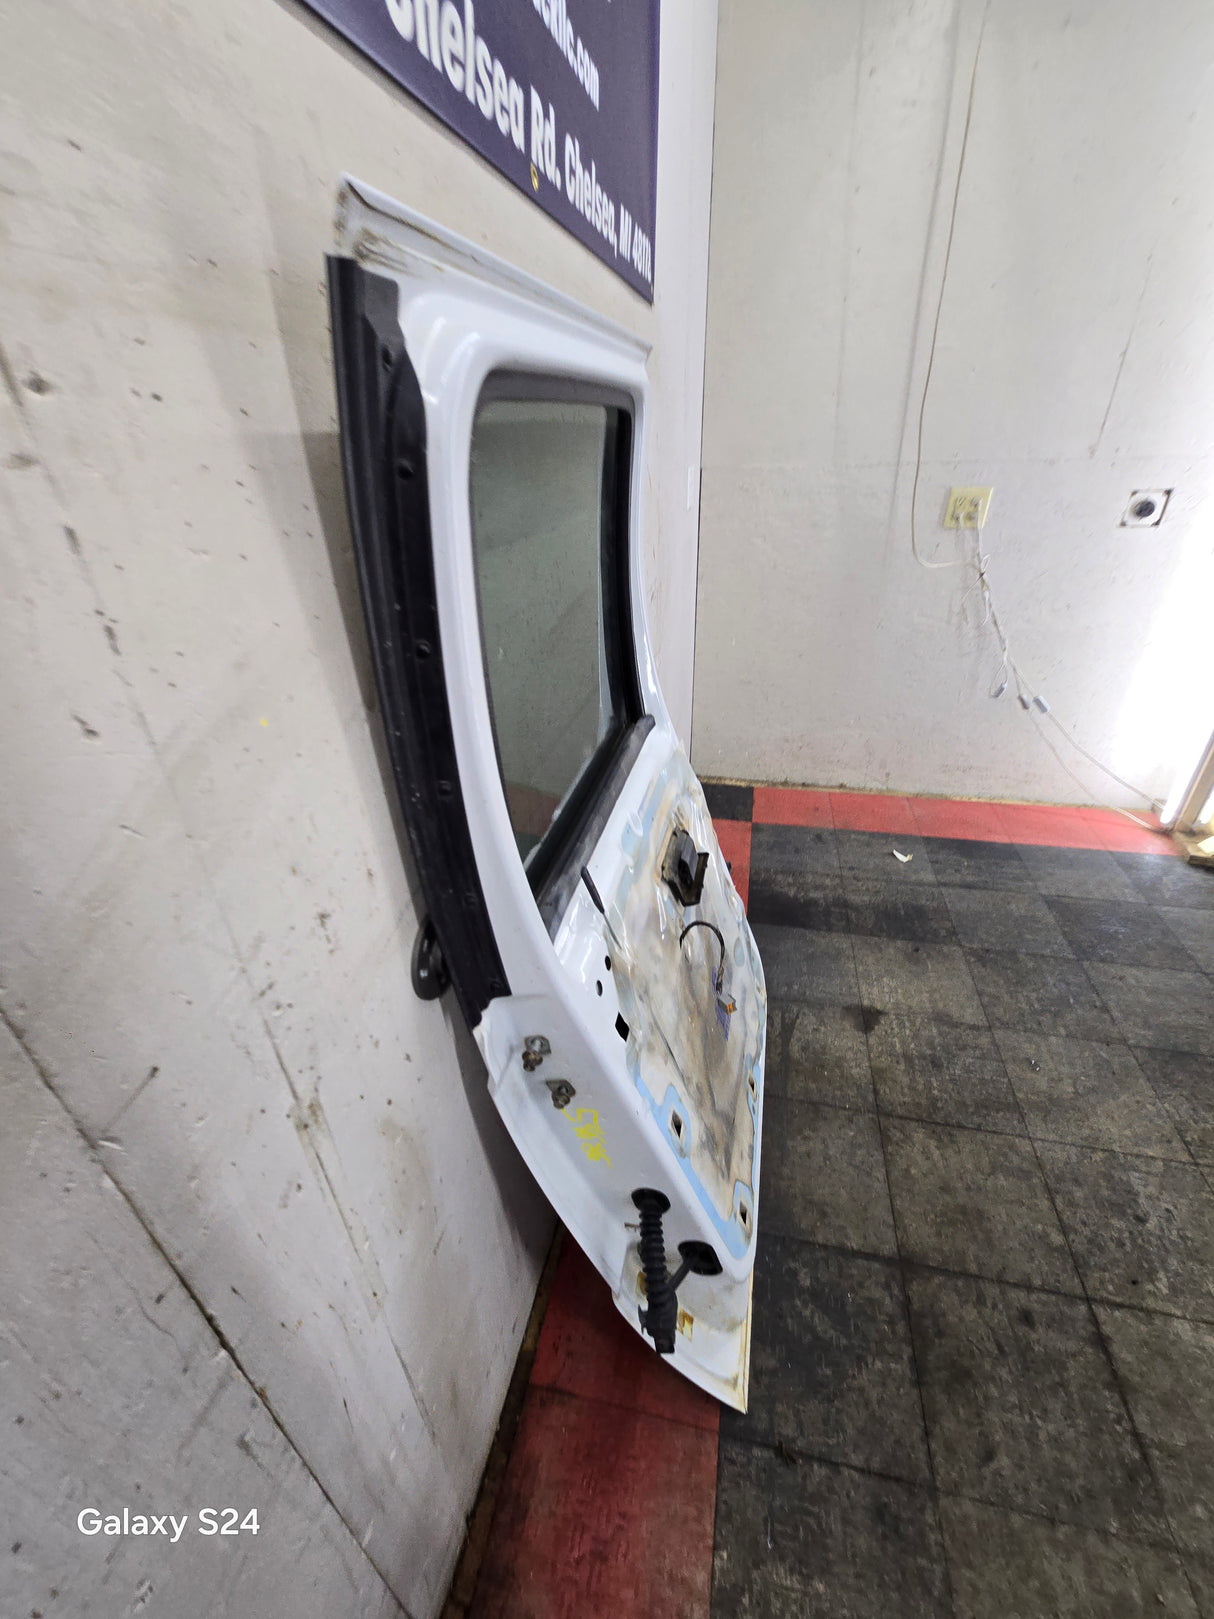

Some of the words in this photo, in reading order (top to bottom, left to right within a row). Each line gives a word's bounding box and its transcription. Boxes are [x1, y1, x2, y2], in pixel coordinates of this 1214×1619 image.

[530, 83, 562, 191] Rd.
[564, 132, 618, 260] Chelsea,
[619, 202, 633, 263] MI
